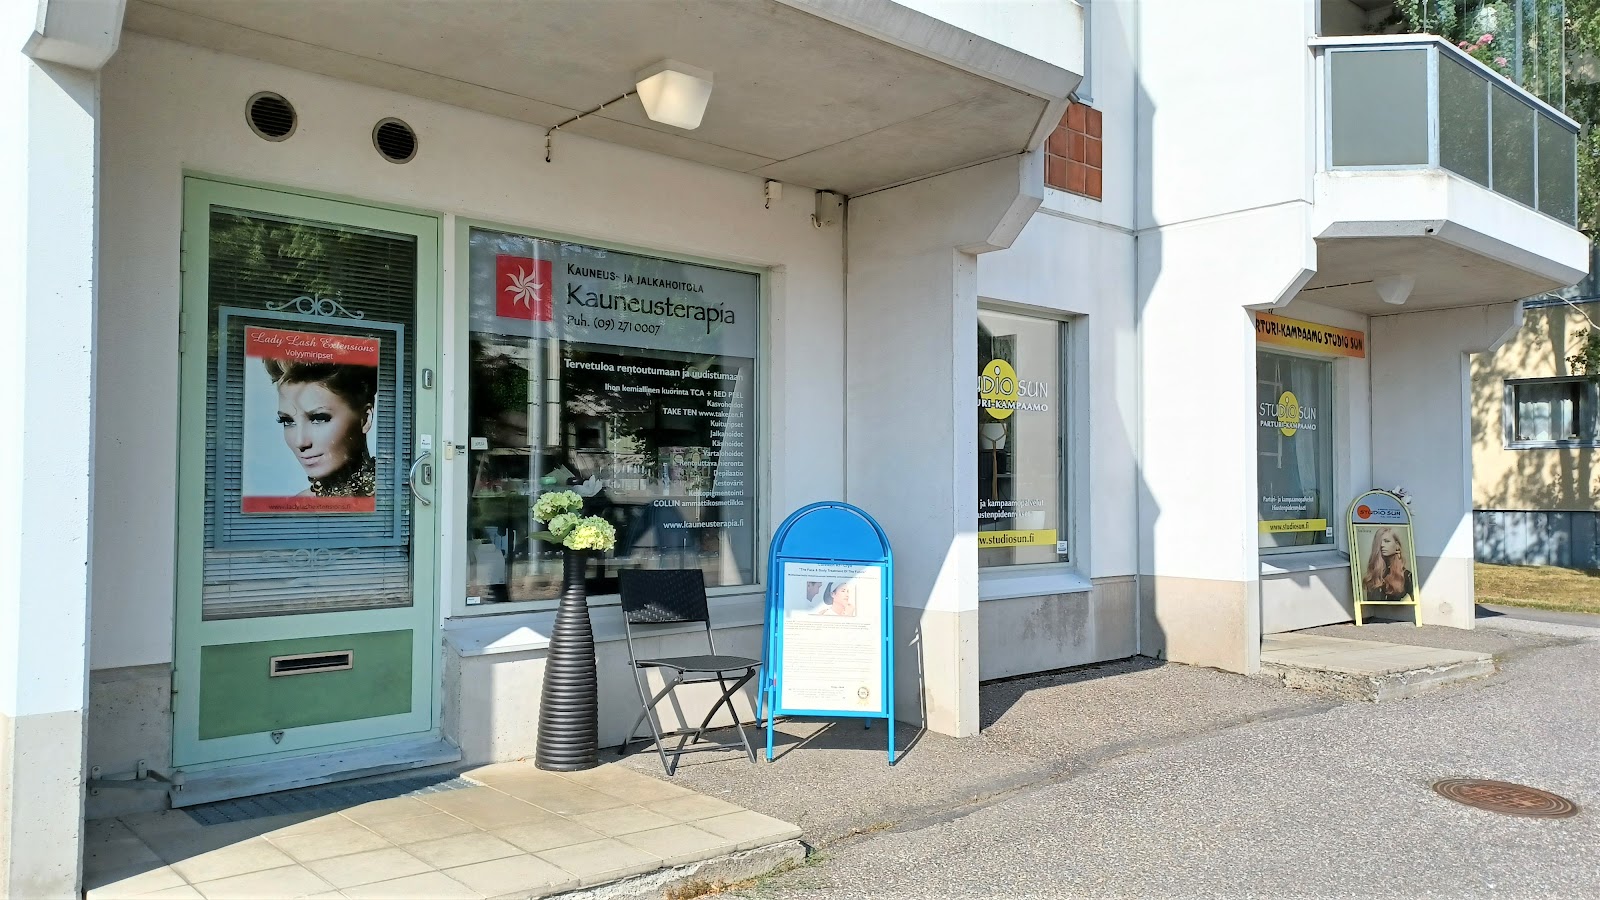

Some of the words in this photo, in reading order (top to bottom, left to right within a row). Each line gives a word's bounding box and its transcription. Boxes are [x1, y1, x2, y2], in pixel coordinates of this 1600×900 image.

[567, 263, 620, 281] KAUNEUS-
[623, 274, 633, 285] JA
[637, 276, 704, 294] JALKAHOITOLA
[566, 283, 735, 334] Kauneusterapia
[567, 313, 590, 328] Puh.
[594, 317, 615, 332] (09)
[618, 321, 632, 333] 271
[634, 322, 661, 336] 0007
[251, 332, 284, 347] Lady
[286, 335, 317, 347] Lash
[320, 338, 374, 353] Extensions
[1324, 332, 1349, 349] STUDIO
[1350, 337, 1363, 351] SUN
[285, 349, 334, 360] Volyymiripset
[564, 358, 615, 372] Tervetuloa
[617, 365, 680, 378] rentoutumaan
[682, 369, 690, 379] ja
[692, 371, 743, 381] uudistumaan
[605, 383, 620, 392] Ihon
[622, 384, 660, 394] kemiallinen
[690, 389, 704, 397] TCA
[714, 390, 726, 398] RED
[728, 391, 743, 399] PEEL
[1017, 380, 1048, 398] SUN
[663, 407, 681, 416] TAKE
[683, 408, 697, 416] TEN
[1259, 396, 1297, 419] STUDIO
[1299, 406, 1316, 420] SUN
[710, 430, 744, 438] Jalkahoidot
[1260, 420, 1316, 431] PARTURI-KAMPAAMO
[681, 499, 744, 507] ammattikosmetiikka
[980, 499, 986, 509] ja
[663, 518, 744, 529] www.kauneusterapia.fi
